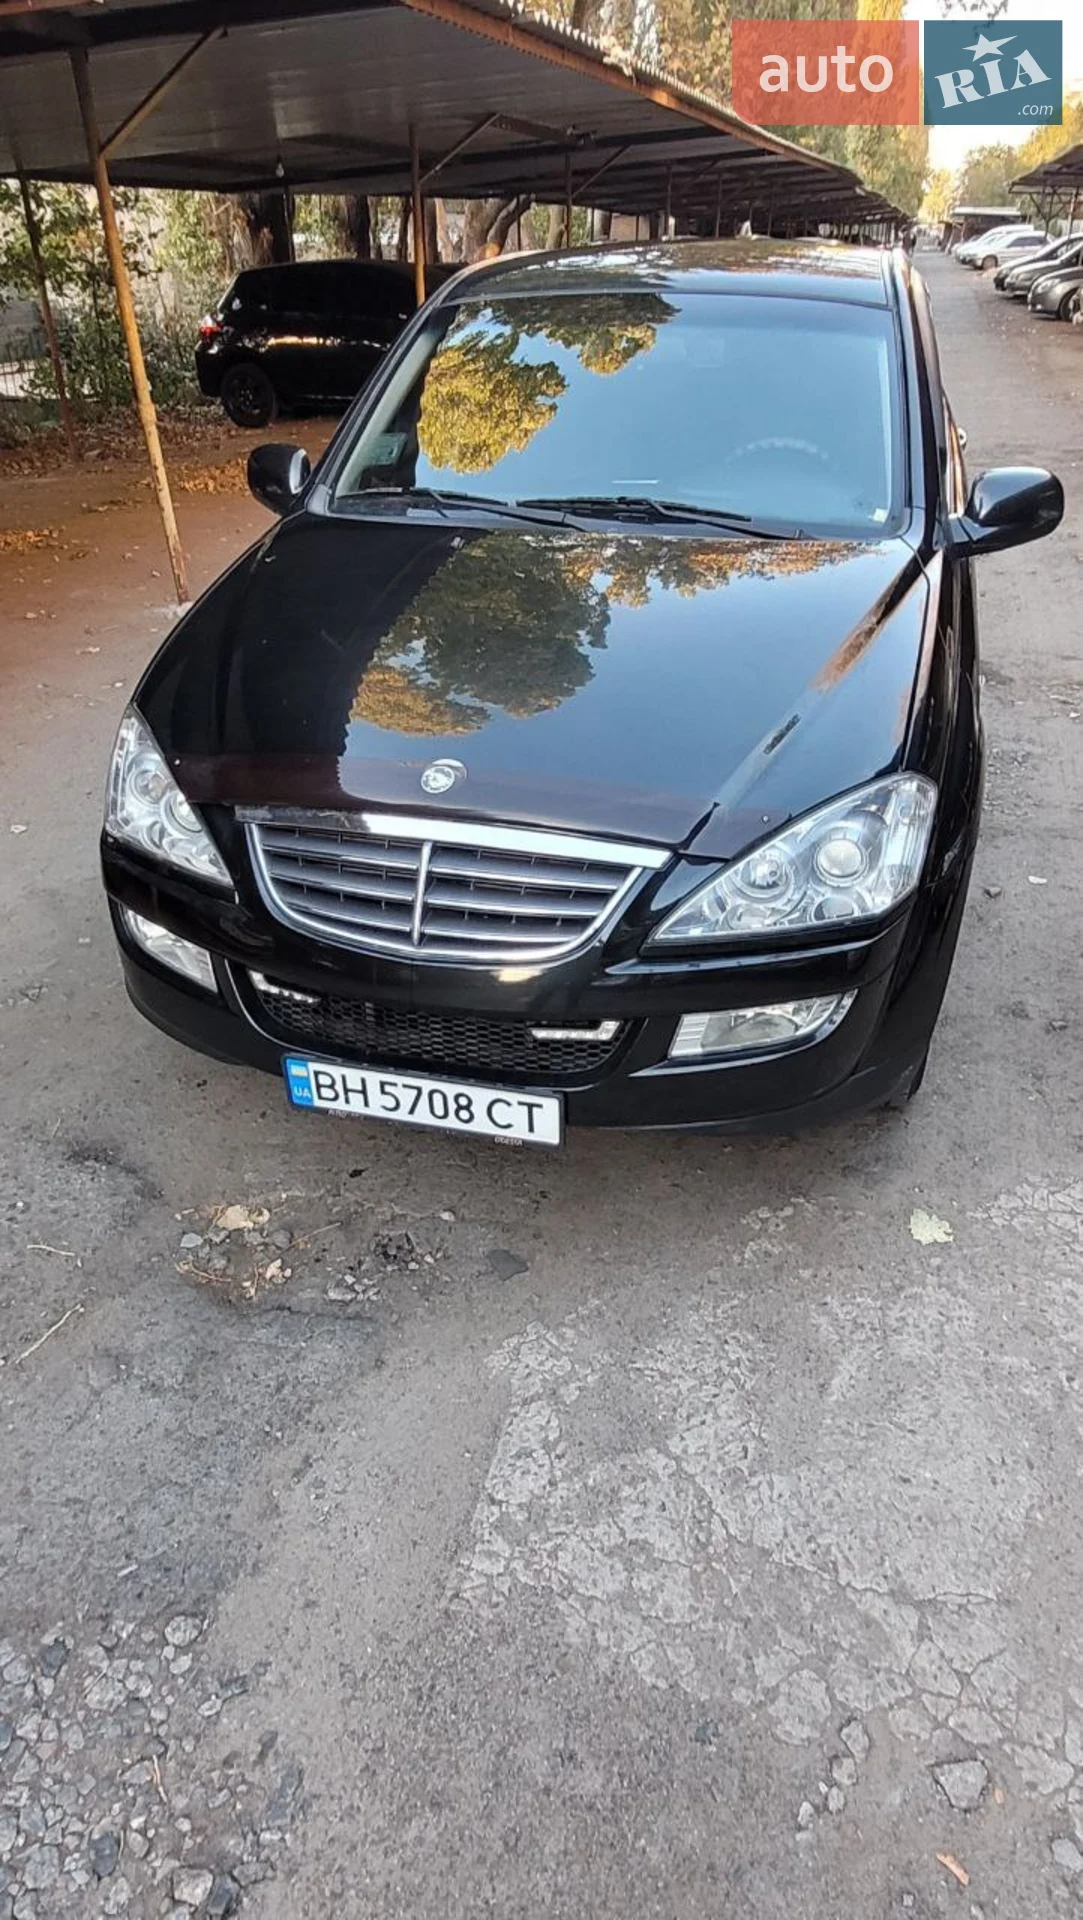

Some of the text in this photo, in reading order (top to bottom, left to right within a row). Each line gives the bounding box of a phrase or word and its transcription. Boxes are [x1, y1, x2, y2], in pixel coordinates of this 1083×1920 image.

[294, 1085, 312, 1099] UA
[313, 1070, 544, 1133] BH 5708 CT
